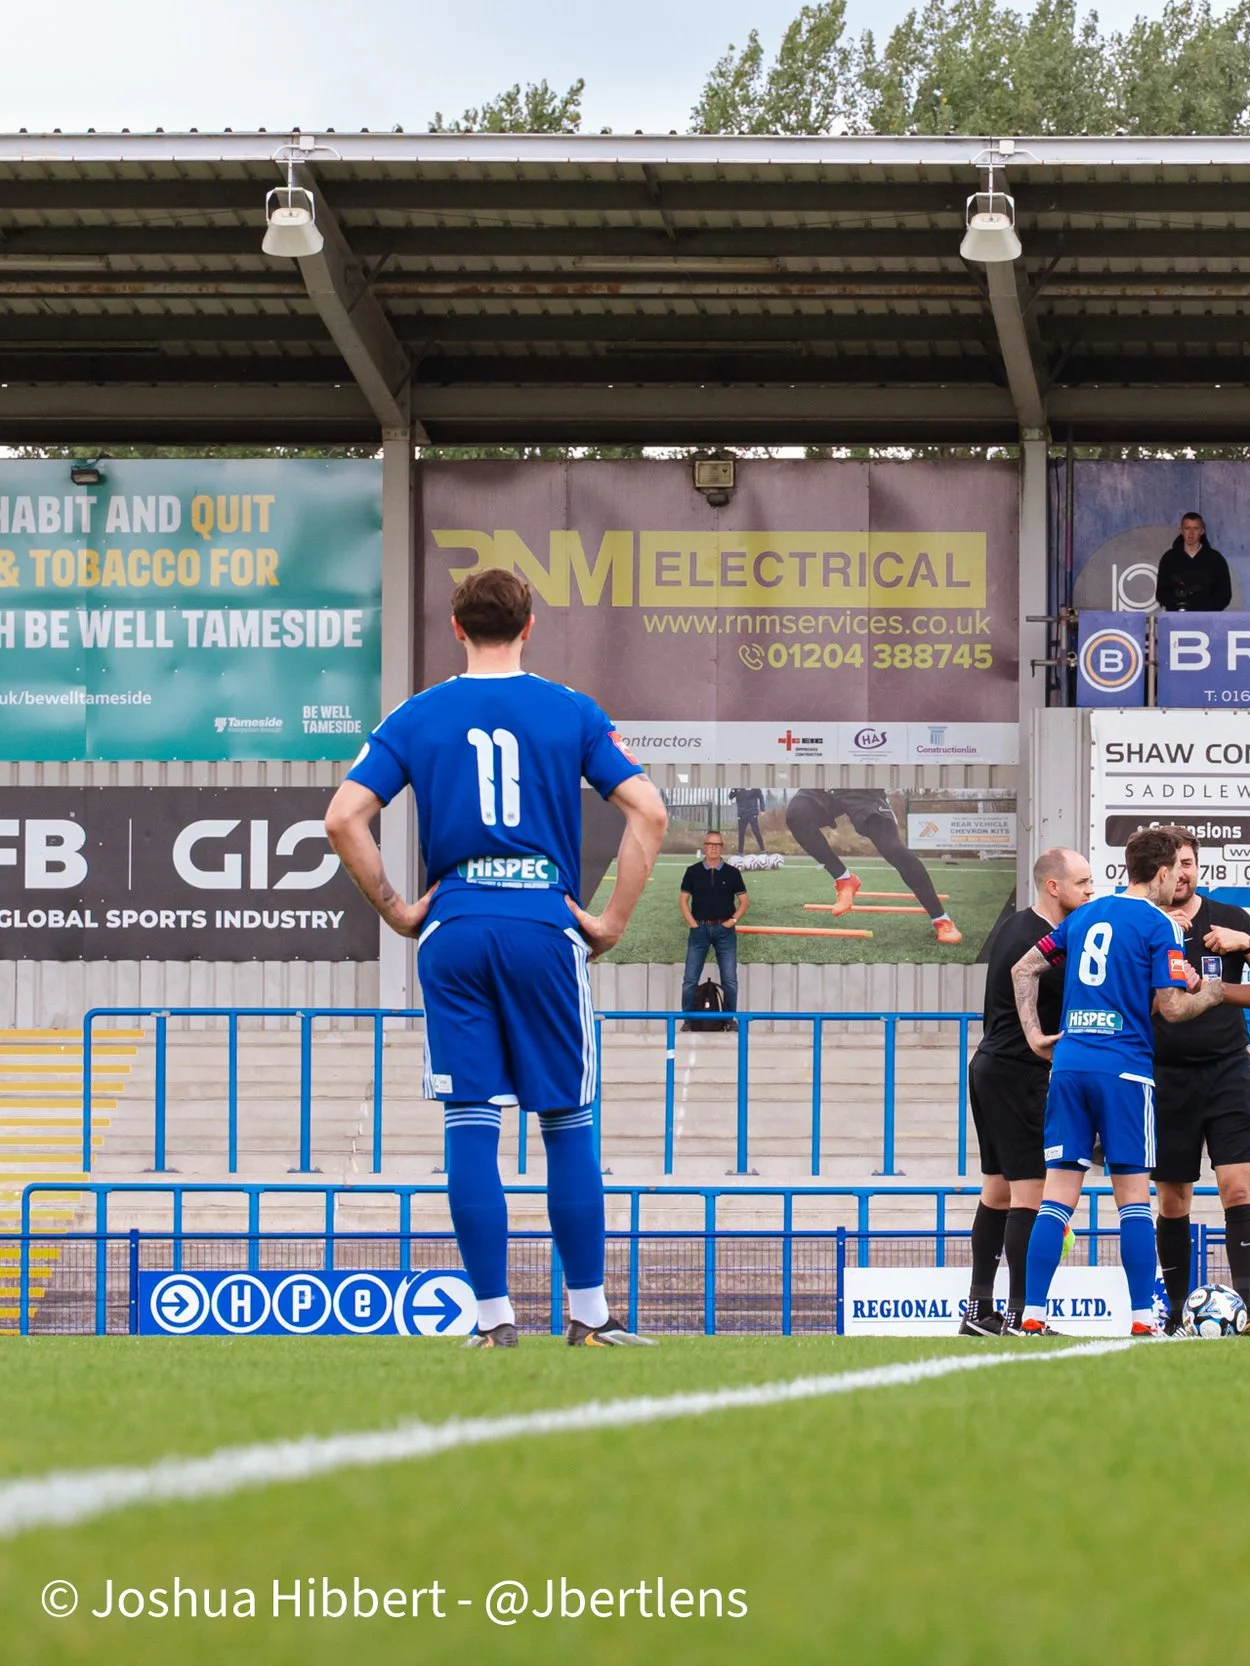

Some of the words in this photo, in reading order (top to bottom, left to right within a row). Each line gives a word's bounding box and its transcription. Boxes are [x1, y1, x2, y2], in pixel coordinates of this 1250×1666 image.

[105, 496, 181, 533] AND
[190, 495, 275, 541] QUIT
[29, 549, 200, 588] TOBACCO
[210, 548, 280, 587] FOR
[655, 551, 970, 589] ELECTRICAL
[24, 610, 70, 649] BE
[77, 609, 173, 649] WELL
[182, 608, 363, 648] TAMESIDE
[643, 610, 991, 635] www.rnmservices.co.uk
[767, 643, 864, 669] 01204
[873, 643, 993, 669] 388745
[1101, 650, 1123, 672] B
[1204, 691, 1217, 701] T:
[228, 717, 283, 728] Tameside
[303, 706, 318, 719] BE
[321, 706, 352, 719] WELL
[302, 720, 361, 733] TAMESIDE
[621, 735, 701, 748] ontractors
[854, 728, 887, 750] CHAS
[1105, 743, 1194, 765] SHAW
[467, 728, 521, 827] 11
[172, 820, 341, 889] GIS
[467, 856, 548, 880] HiSPEC
[0, 909, 98, 928] GLOBAL
[106, 910, 206, 929] SPORTS
[215, 911, 344, 929] INDUSTRY
[1078, 922, 1113, 986] 8
[1069, 1010, 1116, 1028] HiSPEC
[852, 1299, 952, 1318] REGIONAL
[1072, 1299, 1112, 1317] LTD.
